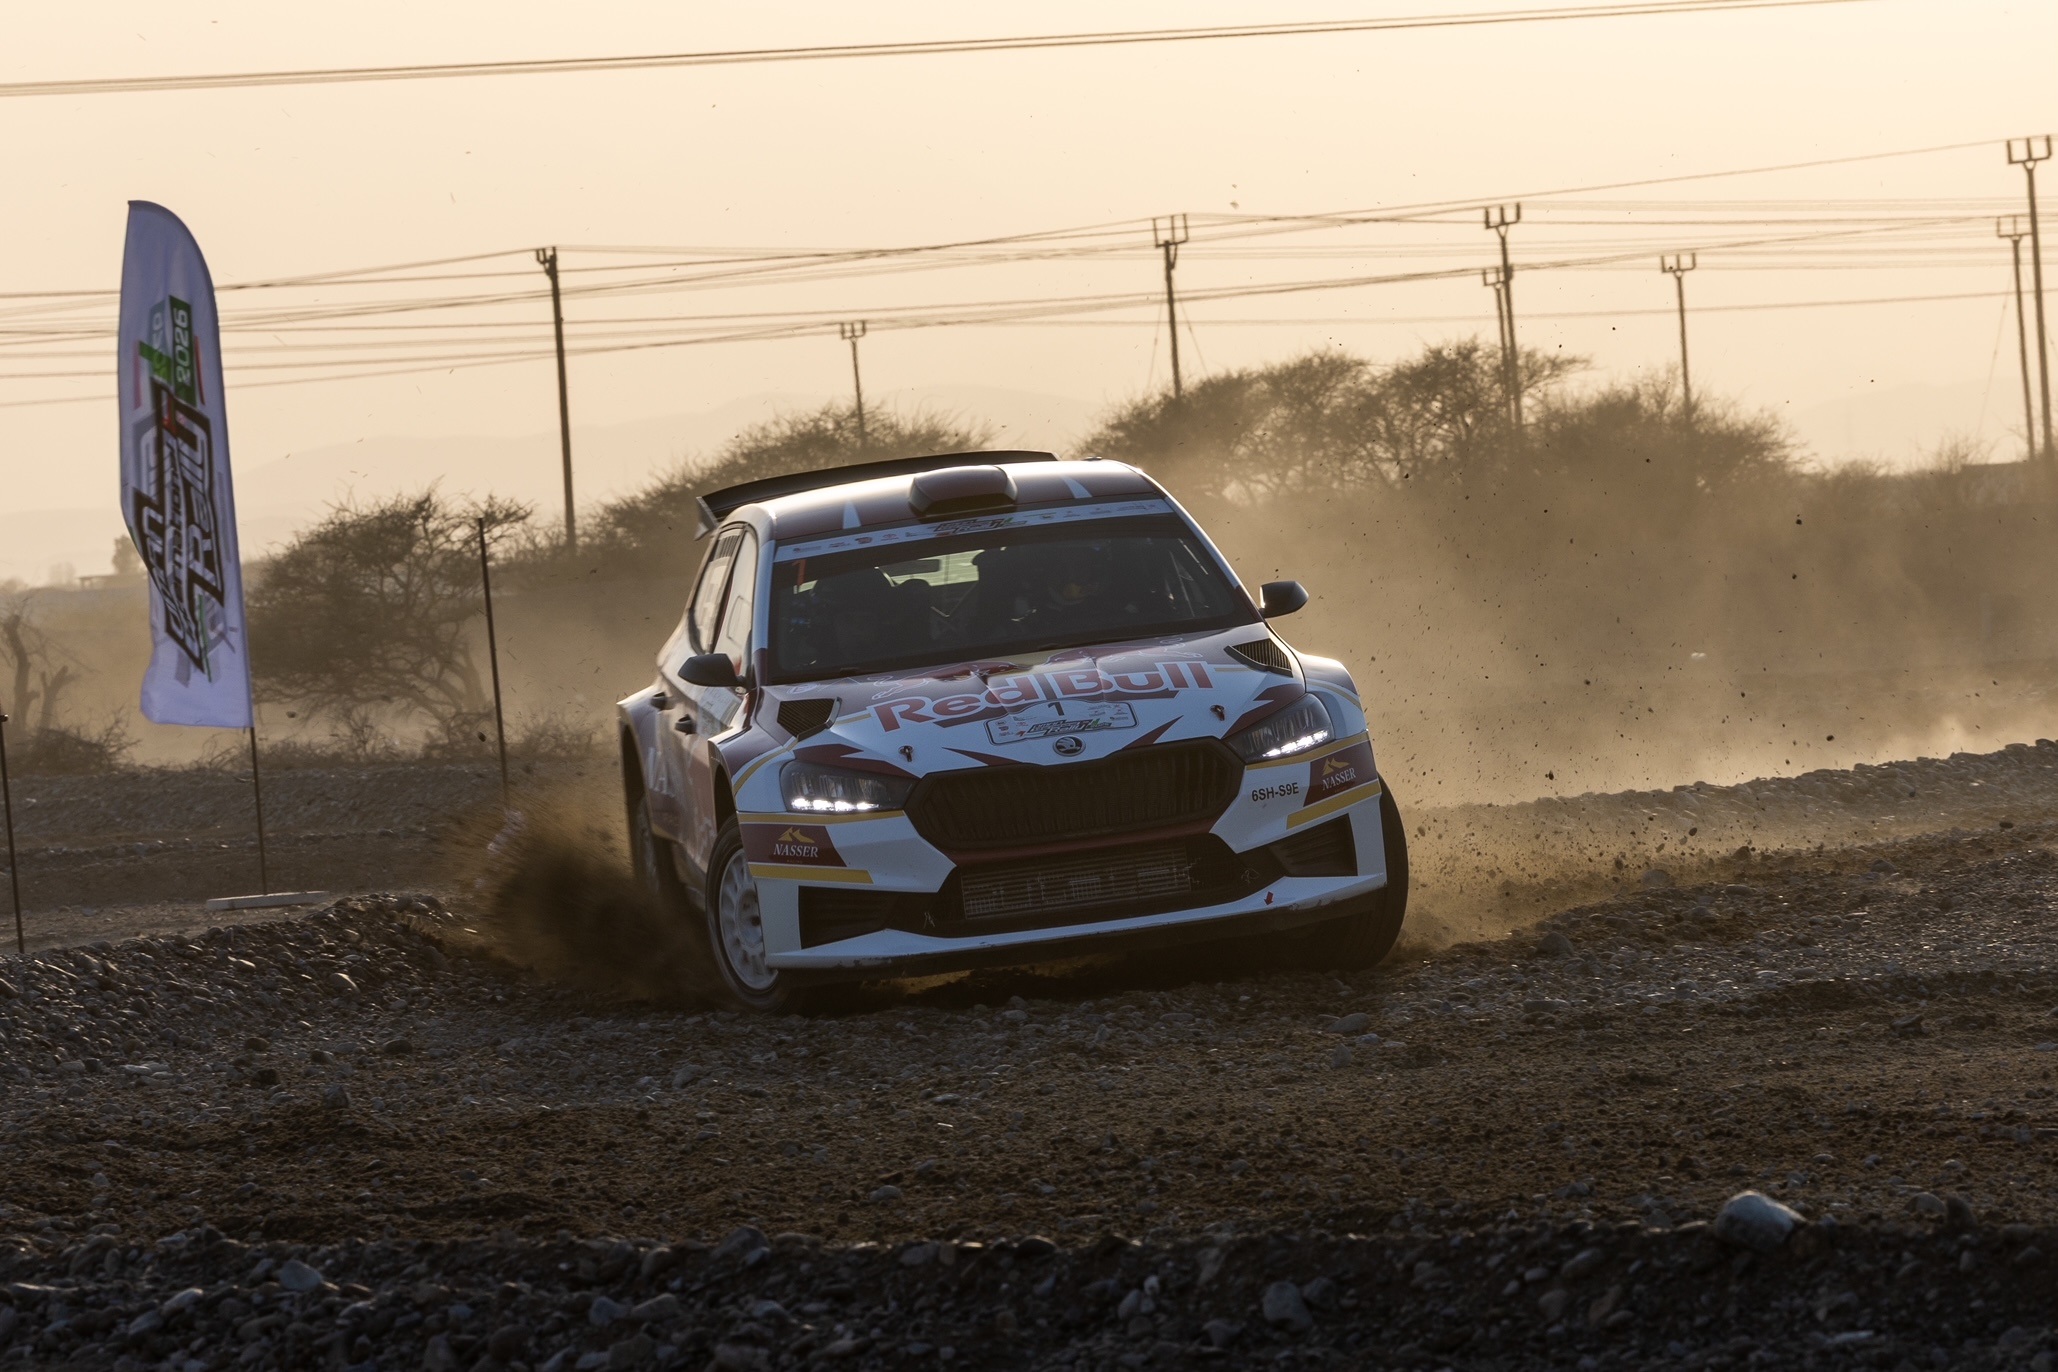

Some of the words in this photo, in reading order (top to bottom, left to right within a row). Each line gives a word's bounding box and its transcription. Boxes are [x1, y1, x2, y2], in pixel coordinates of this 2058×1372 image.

[174, 308, 191, 385] 2026
[176, 411, 217, 590] Rally
[873, 675, 1040, 733] Red
[1051, 662, 1214, 698] Bull
[1047, 701, 1065, 716] 1
[1322, 767, 1357, 791] NASSER
[1251, 782, 1300, 802] 6SH-S9E
[772, 843, 819, 858] NASSER
